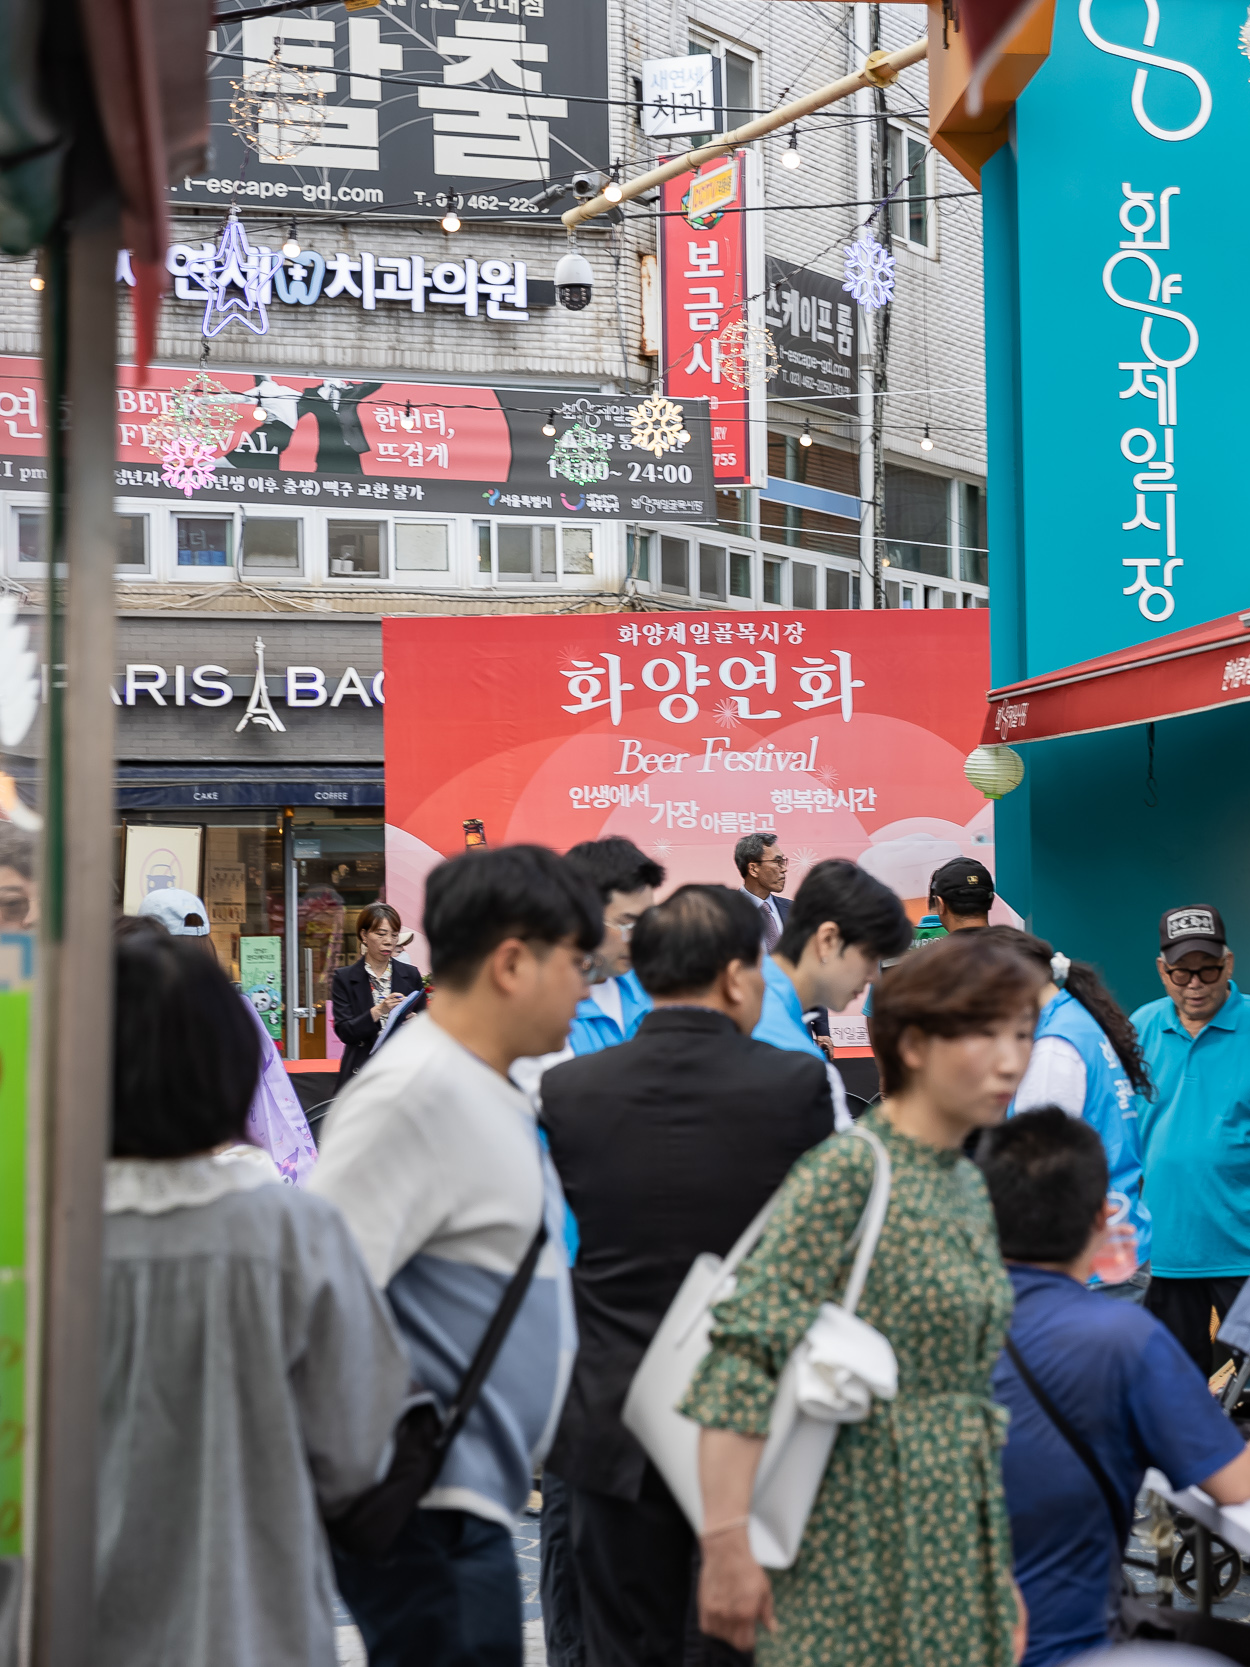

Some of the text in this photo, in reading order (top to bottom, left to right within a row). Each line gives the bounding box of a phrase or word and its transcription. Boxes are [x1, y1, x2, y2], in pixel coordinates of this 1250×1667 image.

[650, 67, 704, 89] 새연세
[207, 16, 568, 181] 탈출
[653, 90, 706, 123] 치과
[184, 175, 384, 203] t-escape-gd.com
[413, 190, 431, 207] T.
[435, 191, 464, 210] 0)
[325, 252, 530, 321] 치과의원
[683, 240, 730, 384] 보금사
[1102, 182, 1200, 622] 화양제일시장
[711, 426, 728, 440] RY
[377, 442, 450, 470] 뜨겁게
[19, 467, 48, 482] pm
[627, 461, 693, 484] 24:00
[248, 476, 280, 493] 이후
[282, 477, 321, 496] 출생)
[357, 482, 390, 499] 교환
[392, 484, 425, 501] 불가
[617, 622, 806, 646] 화양제일골목시장
[560, 649, 866, 727] 화양연화
[613, 735, 820, 775] Beer Festival
[193, 791, 349, 801] CAKE COFFEE
[568, 783, 650, 809] 인생에서
[769, 786, 878, 814] 행복한시간
[649, 800, 700, 829] 가장
[701, 811, 777, 834] 아름답고
